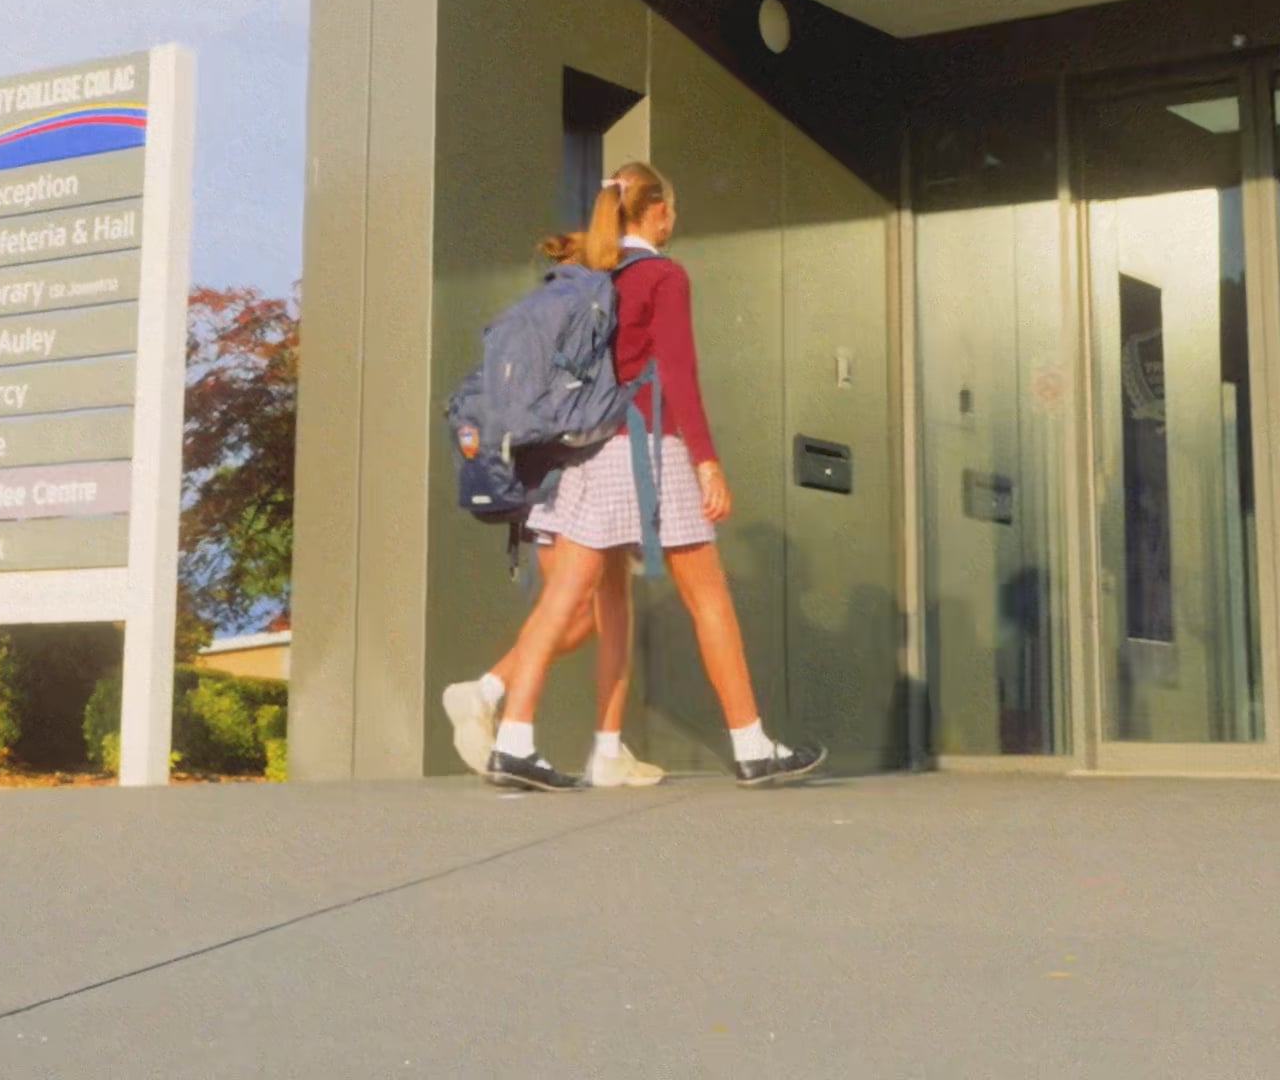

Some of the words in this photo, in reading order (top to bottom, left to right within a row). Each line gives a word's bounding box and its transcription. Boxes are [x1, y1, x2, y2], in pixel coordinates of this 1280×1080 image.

[17, 75, 82, 111] COLLEGE
[86, 66, 134, 98] COLAC
[73, 221, 87, 244] &
[95, 212, 134, 240] Hall
[34, 480, 97, 504] Centre
